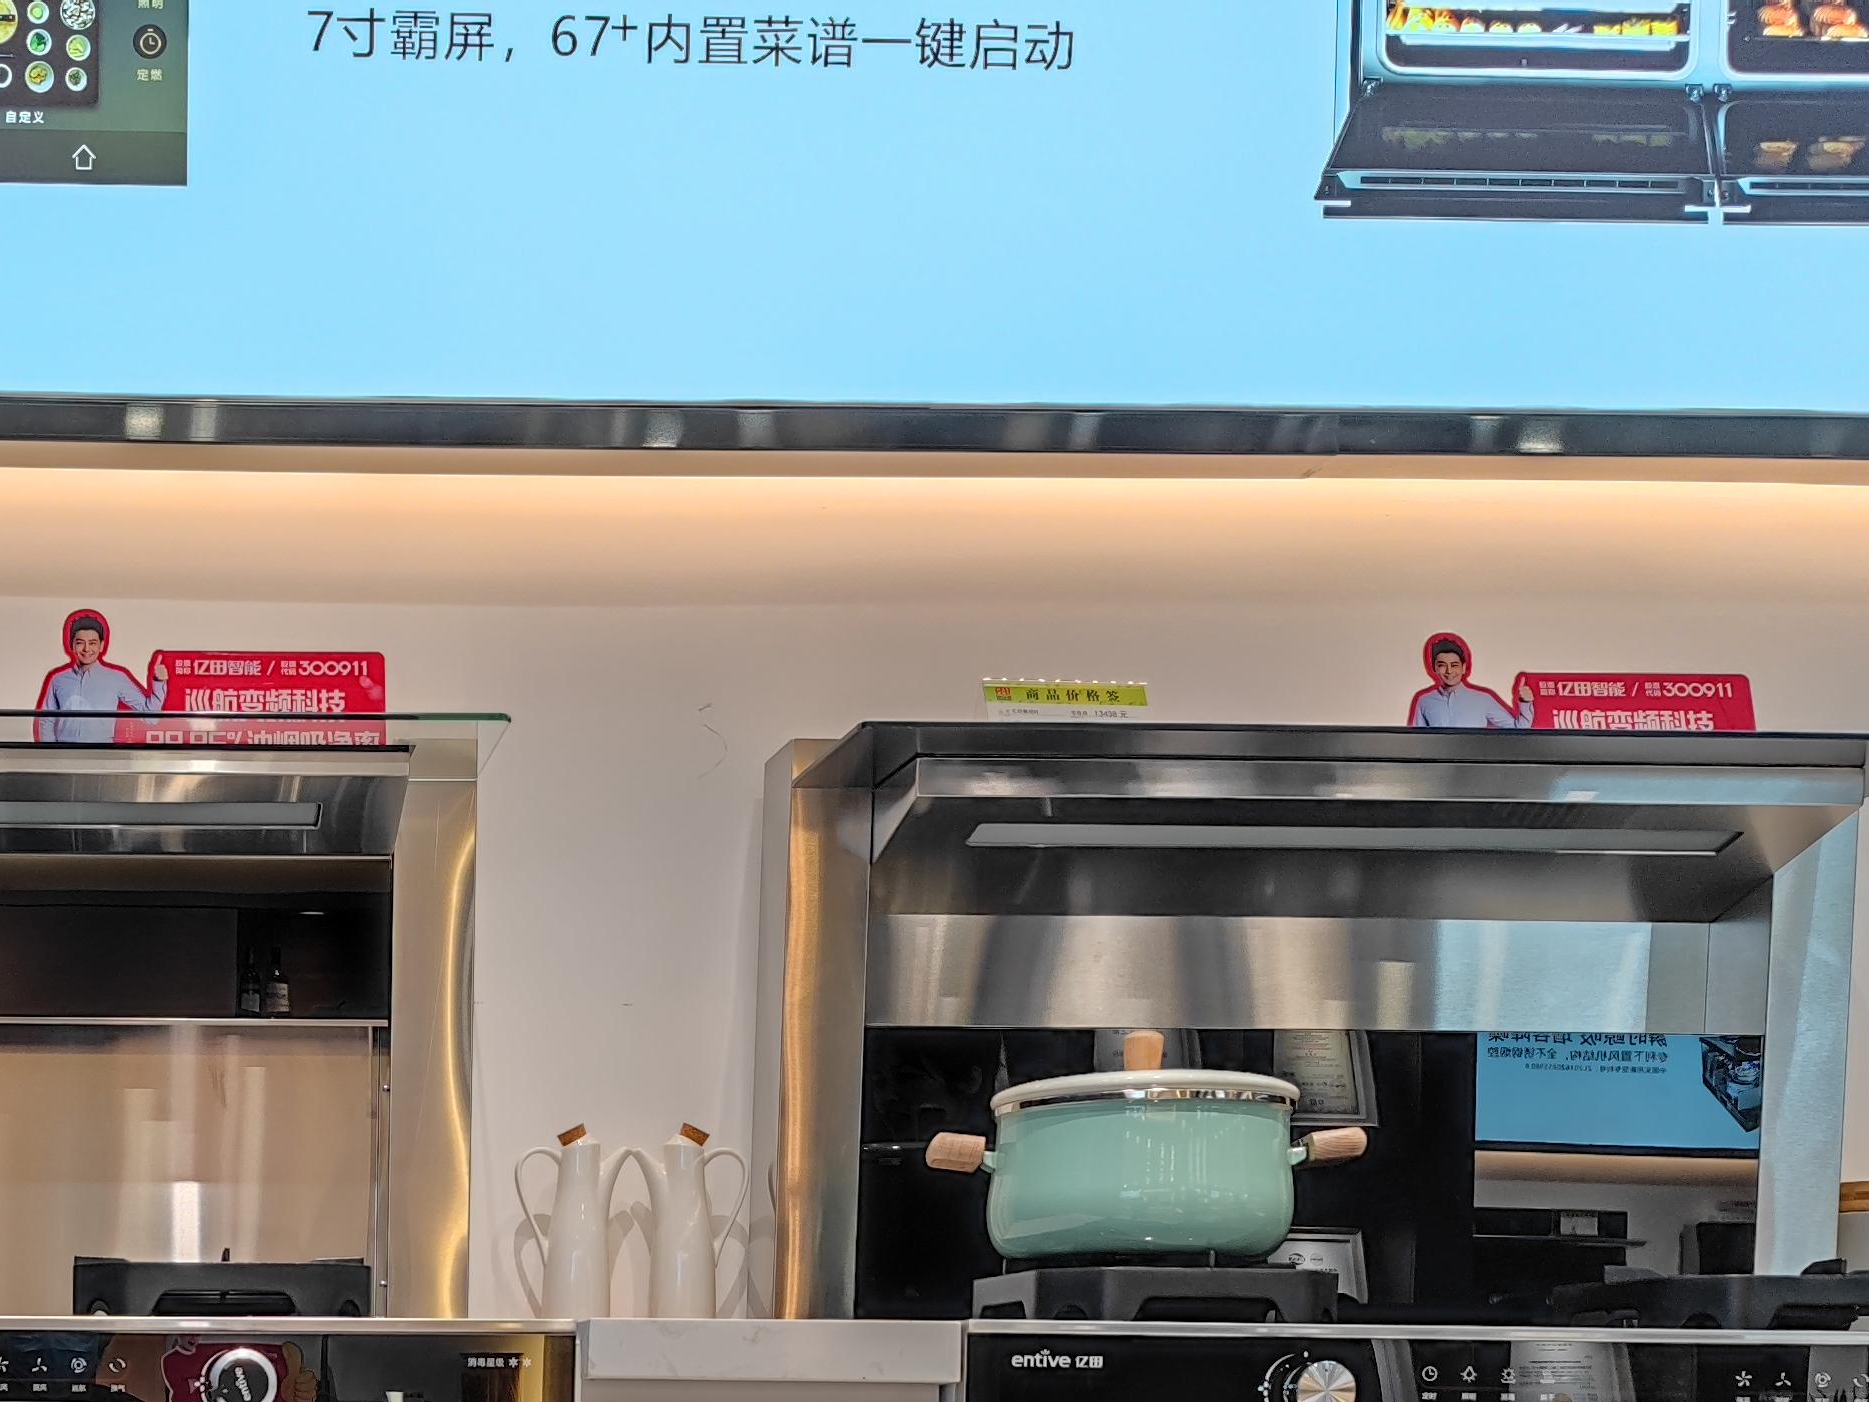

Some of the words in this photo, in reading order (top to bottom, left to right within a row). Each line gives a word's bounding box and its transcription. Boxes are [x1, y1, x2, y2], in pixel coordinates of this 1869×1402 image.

[5, 109, 46, 125] 自定义
[193, 659, 262, 676] 亿田智能
[298, 660, 369, 676] 300911
[1025, 688, 1121, 703] 商品价格签
[1556, 680, 1627, 697] 亿田智能
[1663, 682, 1734, 698] 300911
[185, 688, 346, 713] 巡航变频科技
[1552, 709, 1715, 731] 巡航变频科技
[1010, 1348, 1071, 1369] entive
